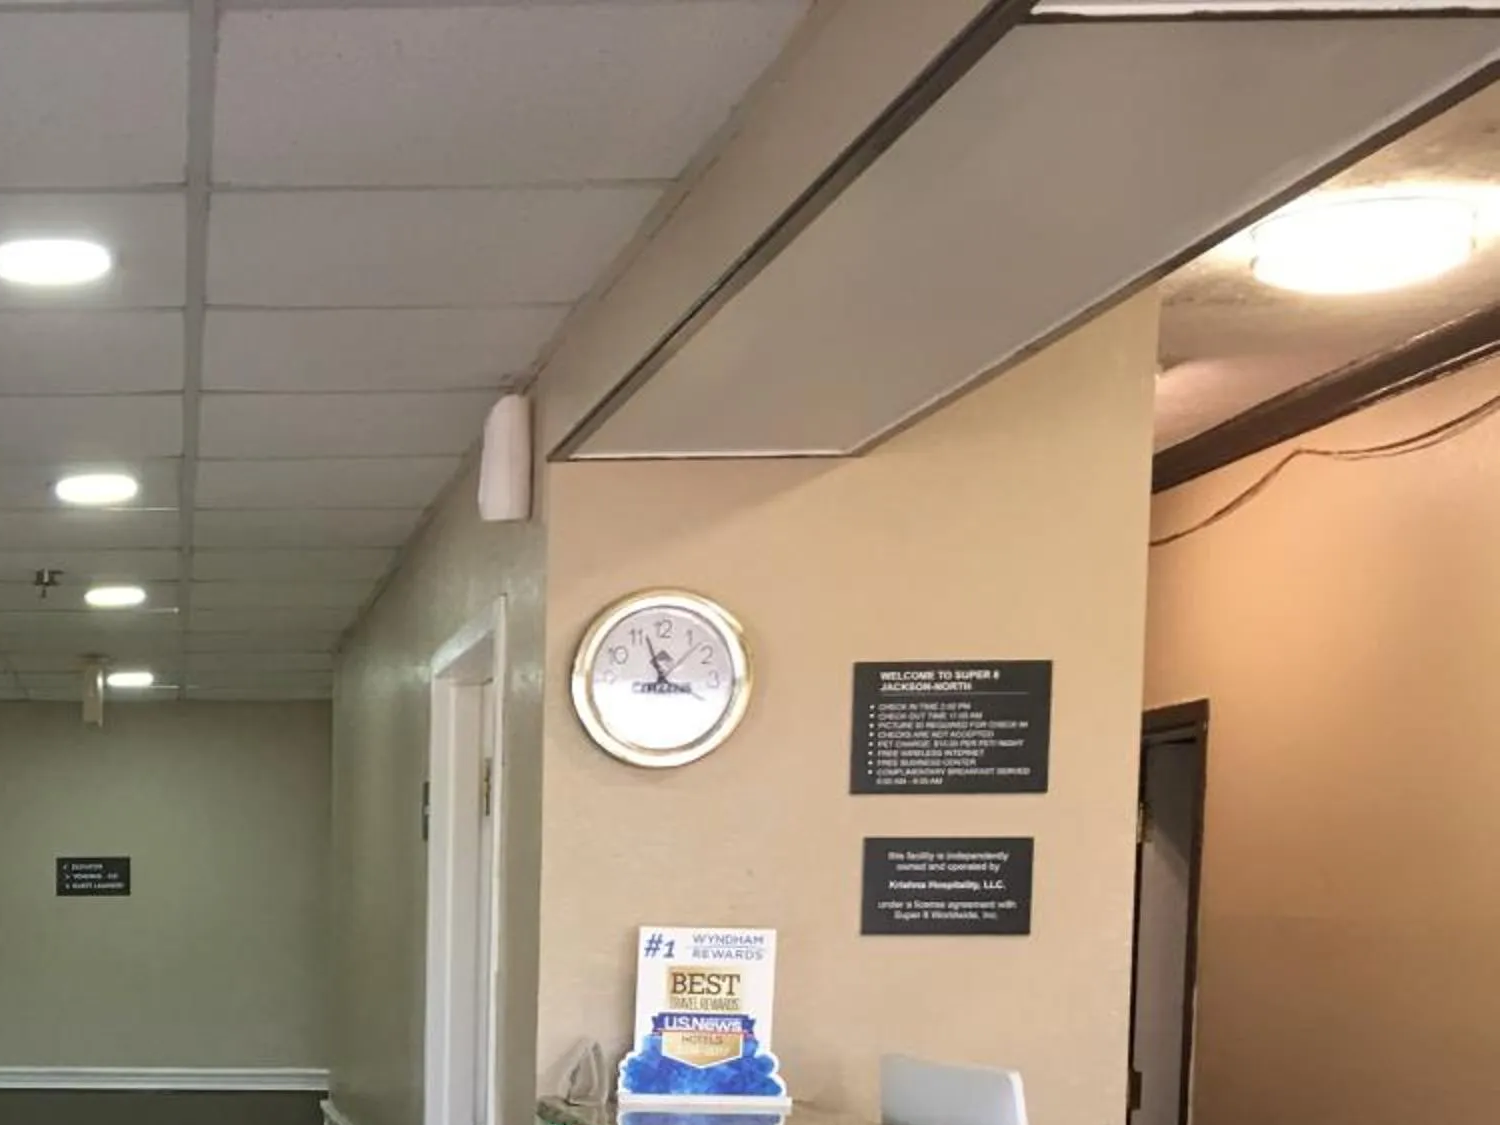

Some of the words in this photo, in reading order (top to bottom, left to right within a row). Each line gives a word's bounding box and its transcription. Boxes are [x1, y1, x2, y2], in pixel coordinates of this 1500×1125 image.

[629, 628, 644, 646] 11
[655, 618, 673, 639] 12
[686, 629, 694, 646] 1
[608, 645, 629, 665] 10
[700, 645, 714, 665] 2
[880, 671, 934, 681] WELCOME
[938, 670, 953, 680] TO
[954, 669, 991, 680] SUPER
[879, 681, 973, 692] JACKSON-NORTH
[888, 880, 927, 890] Krishna
[644, 933, 676, 959] #1
[691, 933, 765, 945] WYNDHAM
[691, 948, 765, 961] REWARDS
[670, 971, 741, 997] BEST
